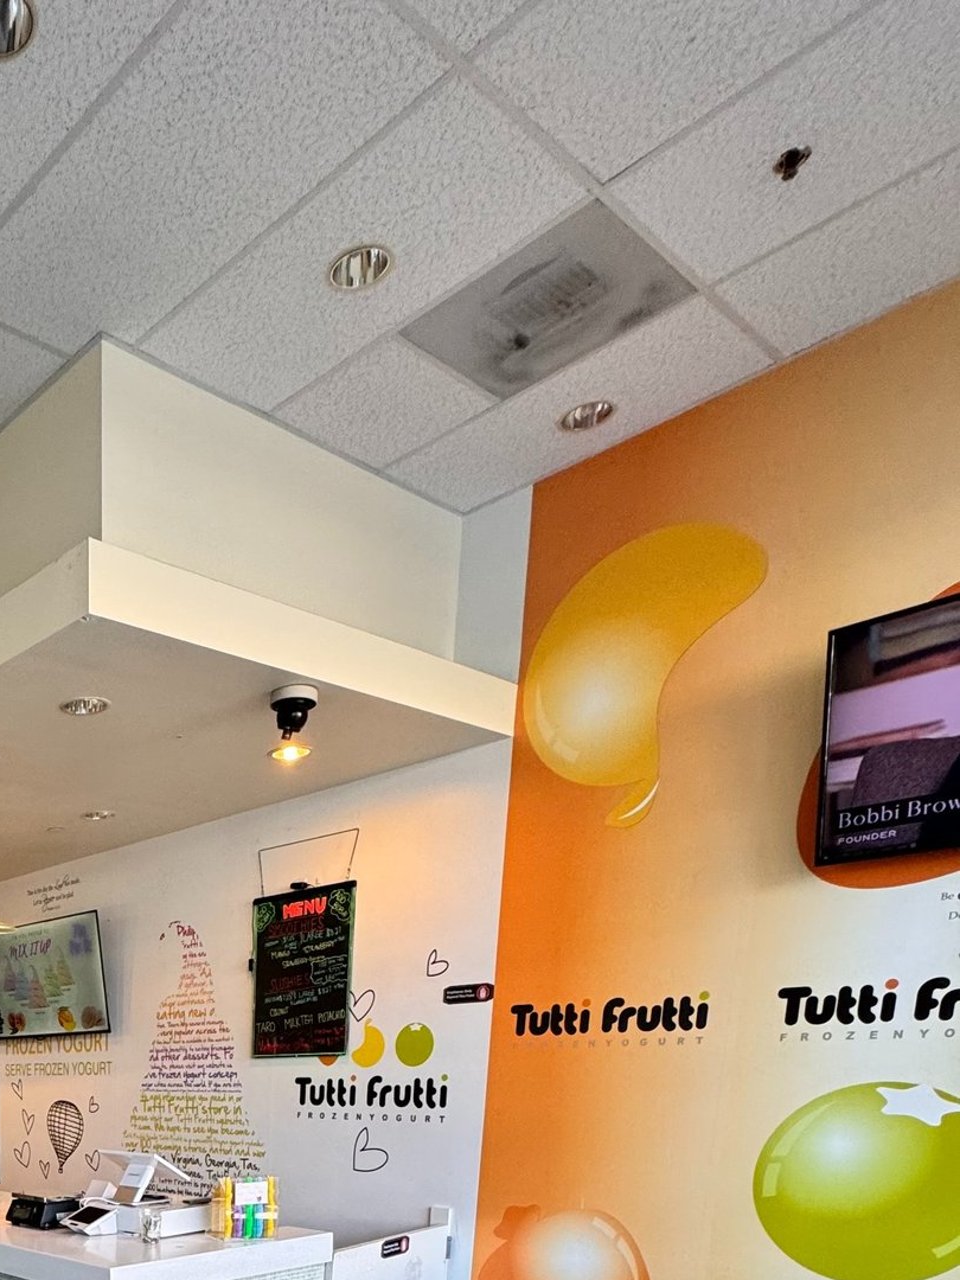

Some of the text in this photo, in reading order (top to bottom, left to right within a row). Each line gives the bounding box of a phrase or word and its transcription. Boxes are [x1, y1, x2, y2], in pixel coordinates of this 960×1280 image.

[838, 804, 901, 829] Bobbi
[837, 829, 897, 846] FOUNDER
[282, 896, 327, 920] MENU
[511, 991, 710, 1036] Tutti Frutti
[778, 978, 899, 1026] Tutti
[5, 1061, 112, 1077] SERVE FROZEN YOGURT
[295, 1074, 448, 1109] Tutti Frutti
